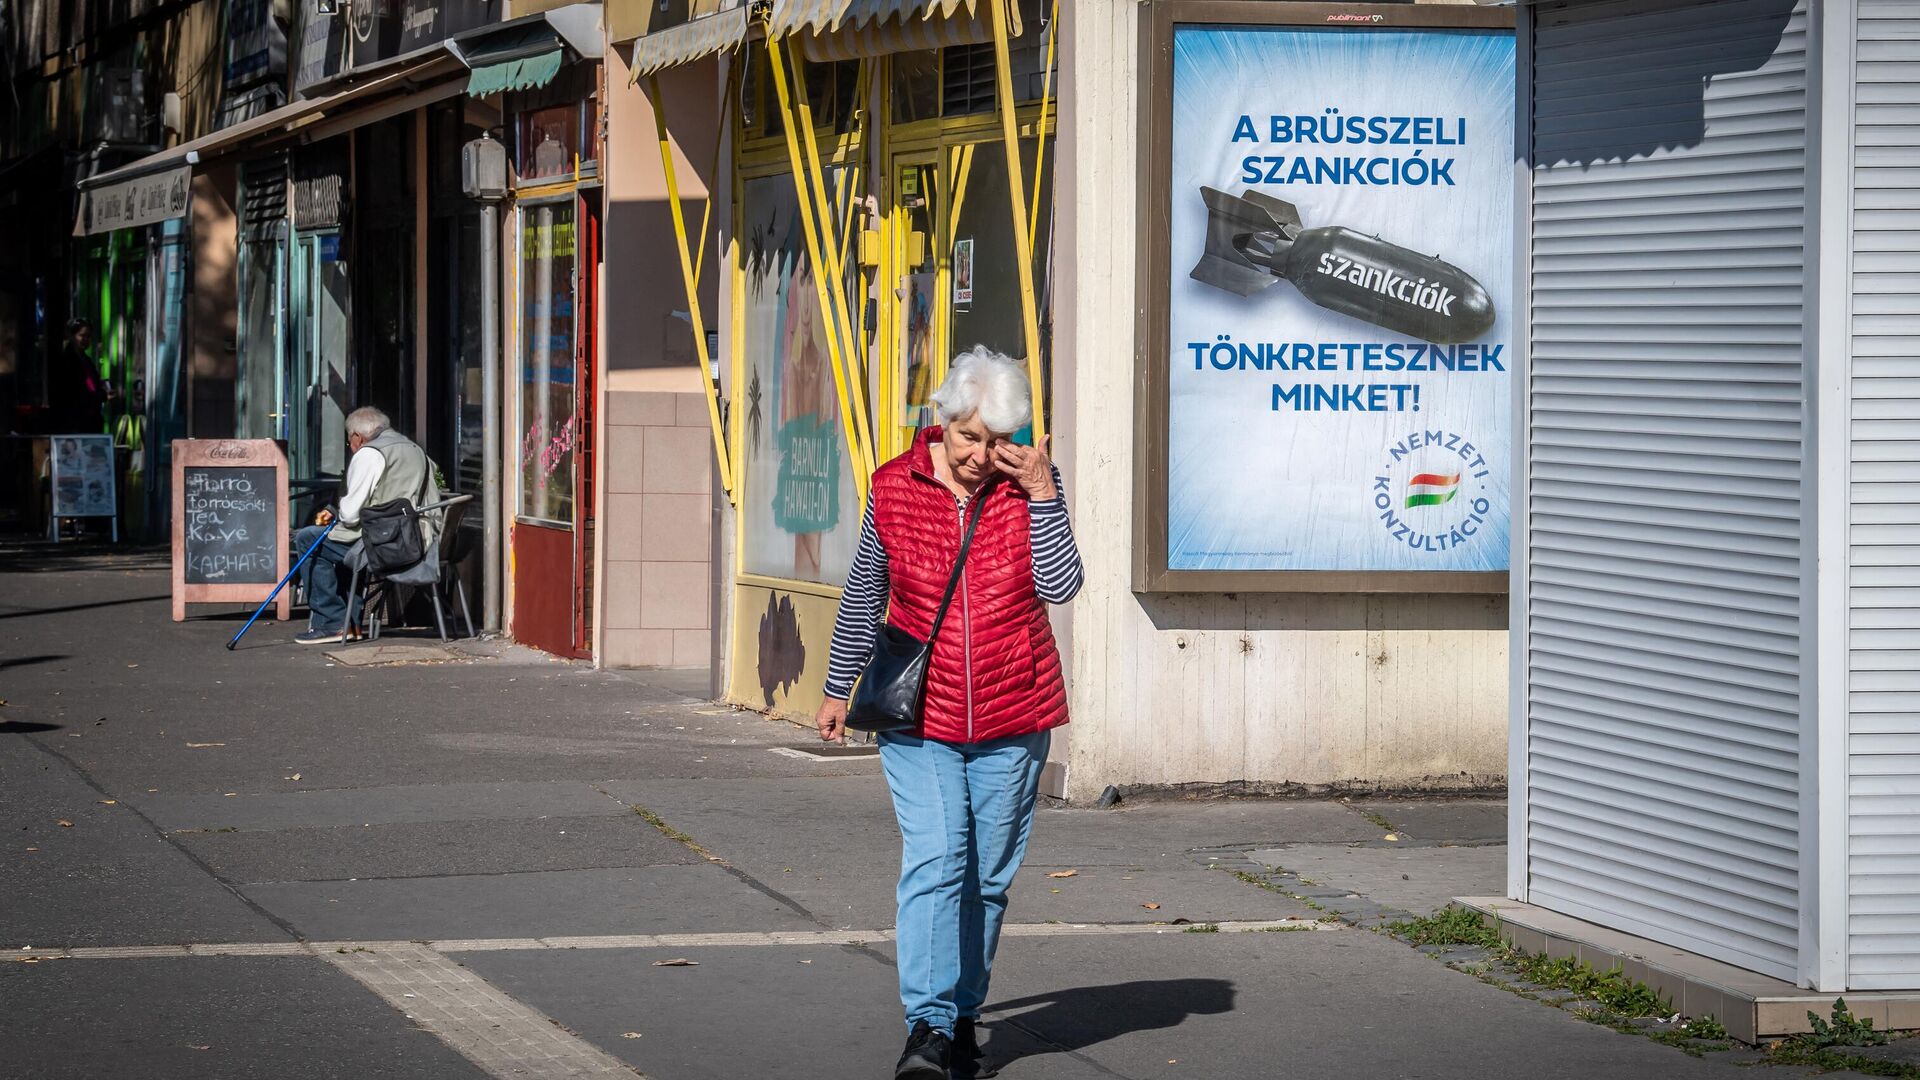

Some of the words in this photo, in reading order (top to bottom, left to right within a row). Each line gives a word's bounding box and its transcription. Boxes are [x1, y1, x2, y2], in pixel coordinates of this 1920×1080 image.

[1231, 115, 1259, 143] A
[1270, 107, 1466, 145] BRÜSSZELI
[1241, 149, 1456, 186] SZANKCIÓK
[1317, 252, 1457, 317] szankciók
[1187, 334, 1506, 372] TÖNKRETESZNEK
[1271, 383, 1420, 412] MINKET!
[791, 437, 830, 478] BARNULJ
[1389, 430, 1489, 479] NEMZETI
[186, 509, 225, 524] Tea
[784, 479, 830, 522] HAWAII-ON
[1374, 476, 1490, 551] KONZULTÁCIÓ
